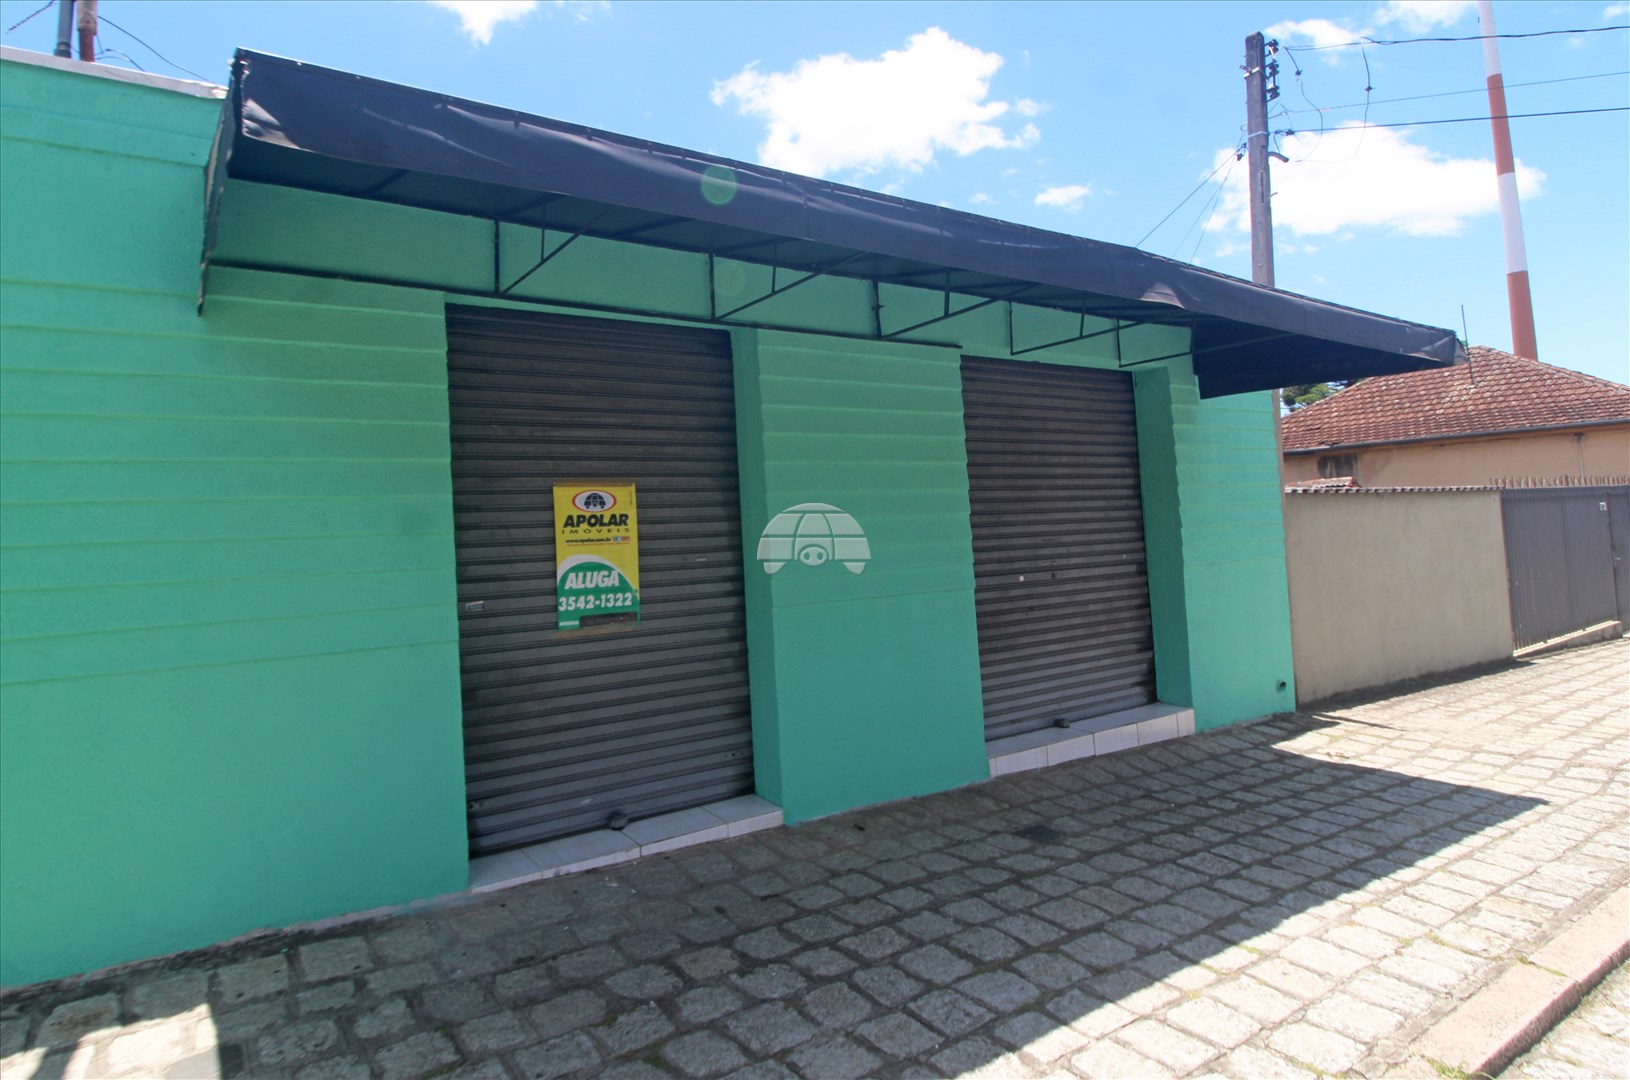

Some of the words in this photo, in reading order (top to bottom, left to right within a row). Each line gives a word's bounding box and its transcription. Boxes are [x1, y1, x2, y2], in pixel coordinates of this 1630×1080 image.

[563, 514, 629, 528] APOLAR
[564, 570, 620, 590] ALUGA
[558, 592, 633, 612] 3542-1322
